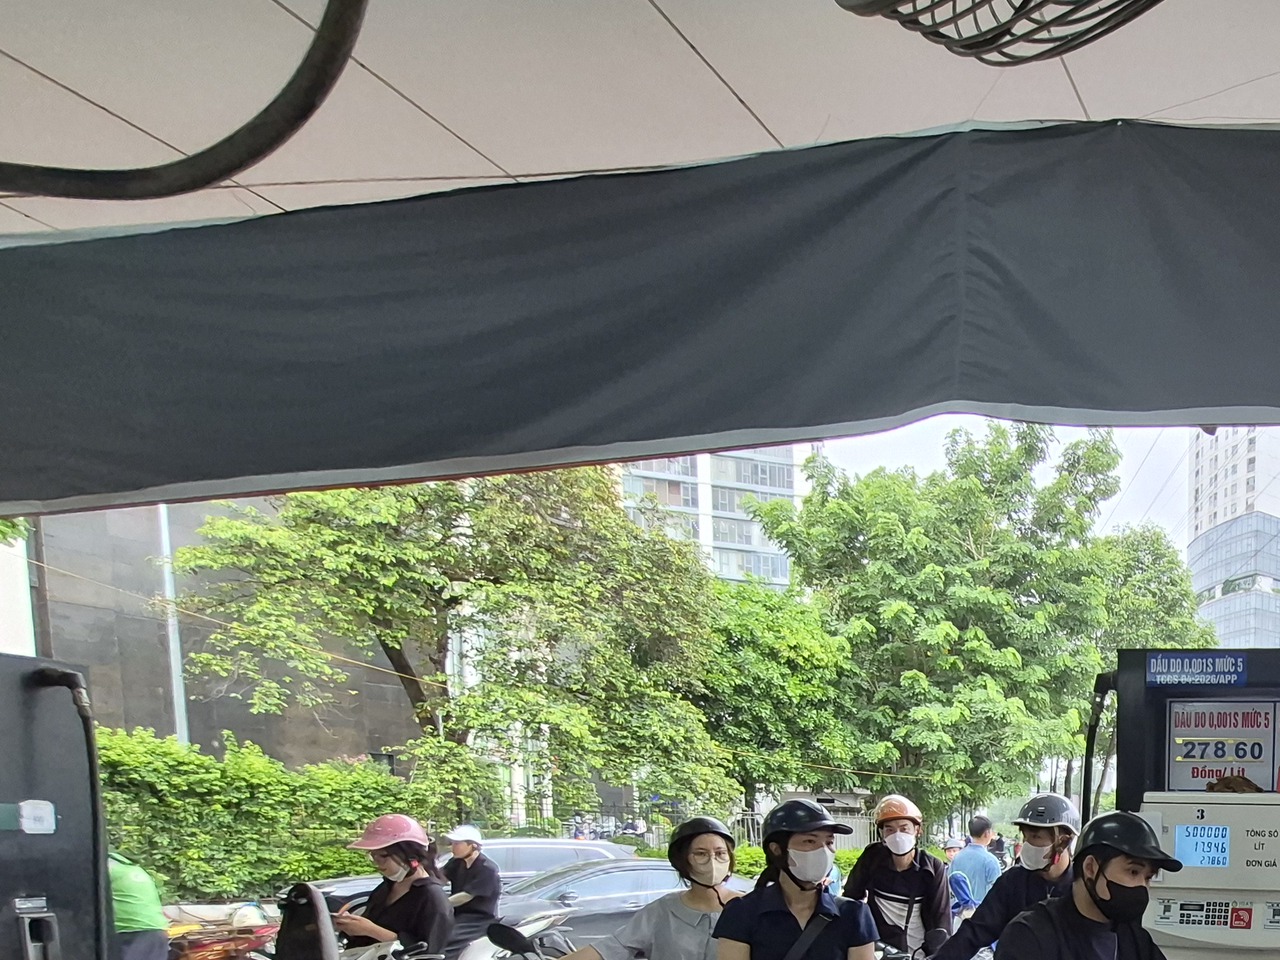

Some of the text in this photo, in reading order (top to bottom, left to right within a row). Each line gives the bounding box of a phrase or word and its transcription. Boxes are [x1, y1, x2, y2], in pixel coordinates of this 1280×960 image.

[1170, 658, 1182, 673] DO
[1184, 657, 1213, 674] 0,001S
[1215, 655, 1236, 673] MỨC
[1237, 658, 1243, 673] 5
[1156, 674, 1179, 684] TCCS
[1194, 711, 1206, 729] DO
[1209, 711, 1239, 730] 0,001S
[1241, 708, 1262, 729] MỨC
[1264, 711, 1270, 729] 5
[1196, 808, 1205, 820] 3
[1185, 826, 1228, 839] 500000
[1254, 841, 1266, 851] LÍT
[1245, 858, 1278, 868] ĐƠN GIÁ
